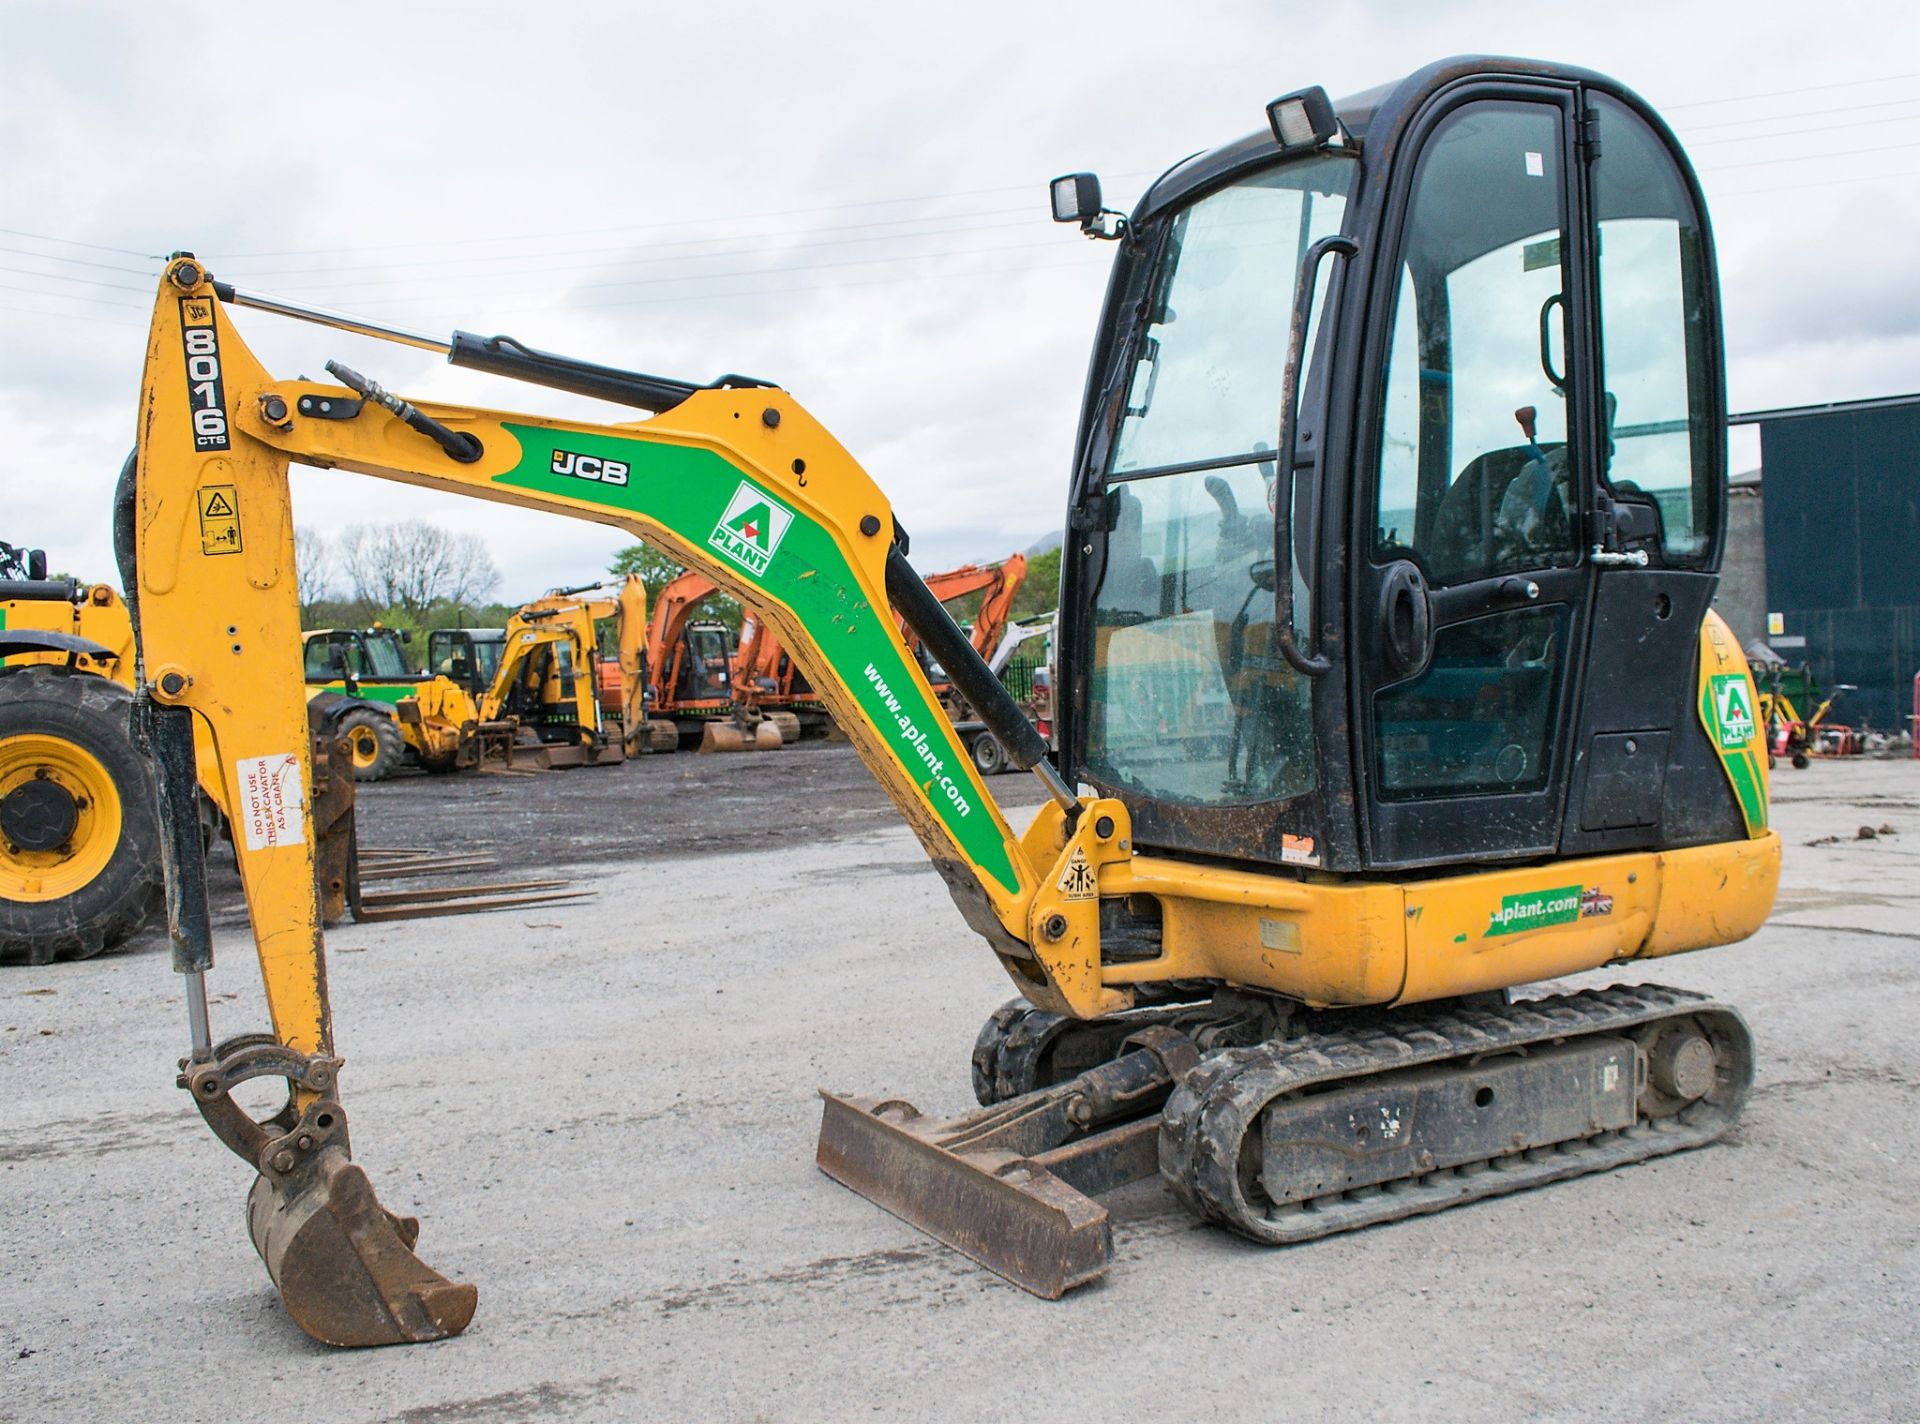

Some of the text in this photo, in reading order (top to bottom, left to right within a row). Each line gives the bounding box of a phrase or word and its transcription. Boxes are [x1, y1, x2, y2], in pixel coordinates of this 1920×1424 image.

[185, 329, 226, 435] 8016
[197, 435, 226, 445] CTS
[553, 451, 628, 485] JCB
[712, 527, 768, 571] PLANT
[726, 501, 771, 552] A
[863, 662, 971, 818] www.aplant.com
[248, 773, 263, 835] DO NOT USE
[259, 760, 277, 846] THIS EXCAVATOR
[271, 772, 286, 830] AS A CRANE
